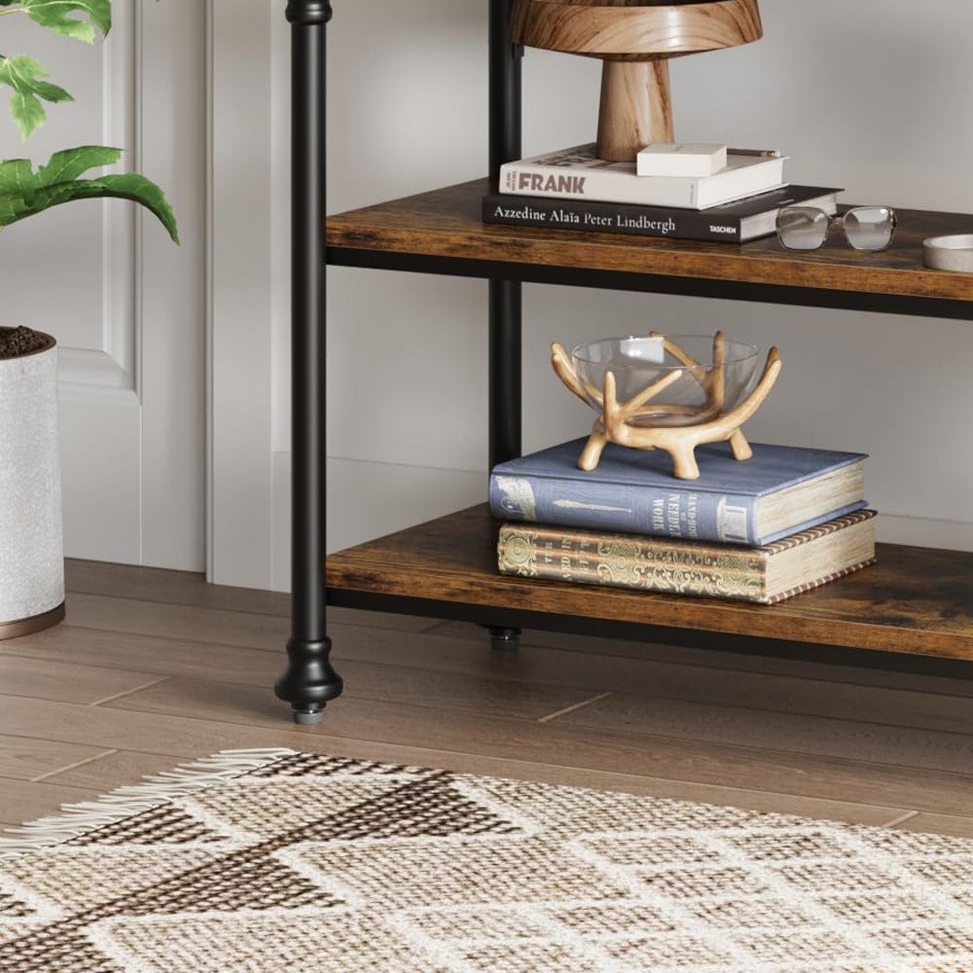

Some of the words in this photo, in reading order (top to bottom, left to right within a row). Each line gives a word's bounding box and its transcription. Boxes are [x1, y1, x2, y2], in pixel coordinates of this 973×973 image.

[518, 172, 586, 194] FRANK
[494, 205, 546, 222] Azzedine
[550, 208, 580, 224] Alaïa
[583, 212, 613, 227] Peter
[616, 213, 676, 233] Lindbergh
[709, 225, 737, 234] TASCHEN
[653, 499, 665, 530] WORK
[688, 492, 698, 541] HAND-BOO
